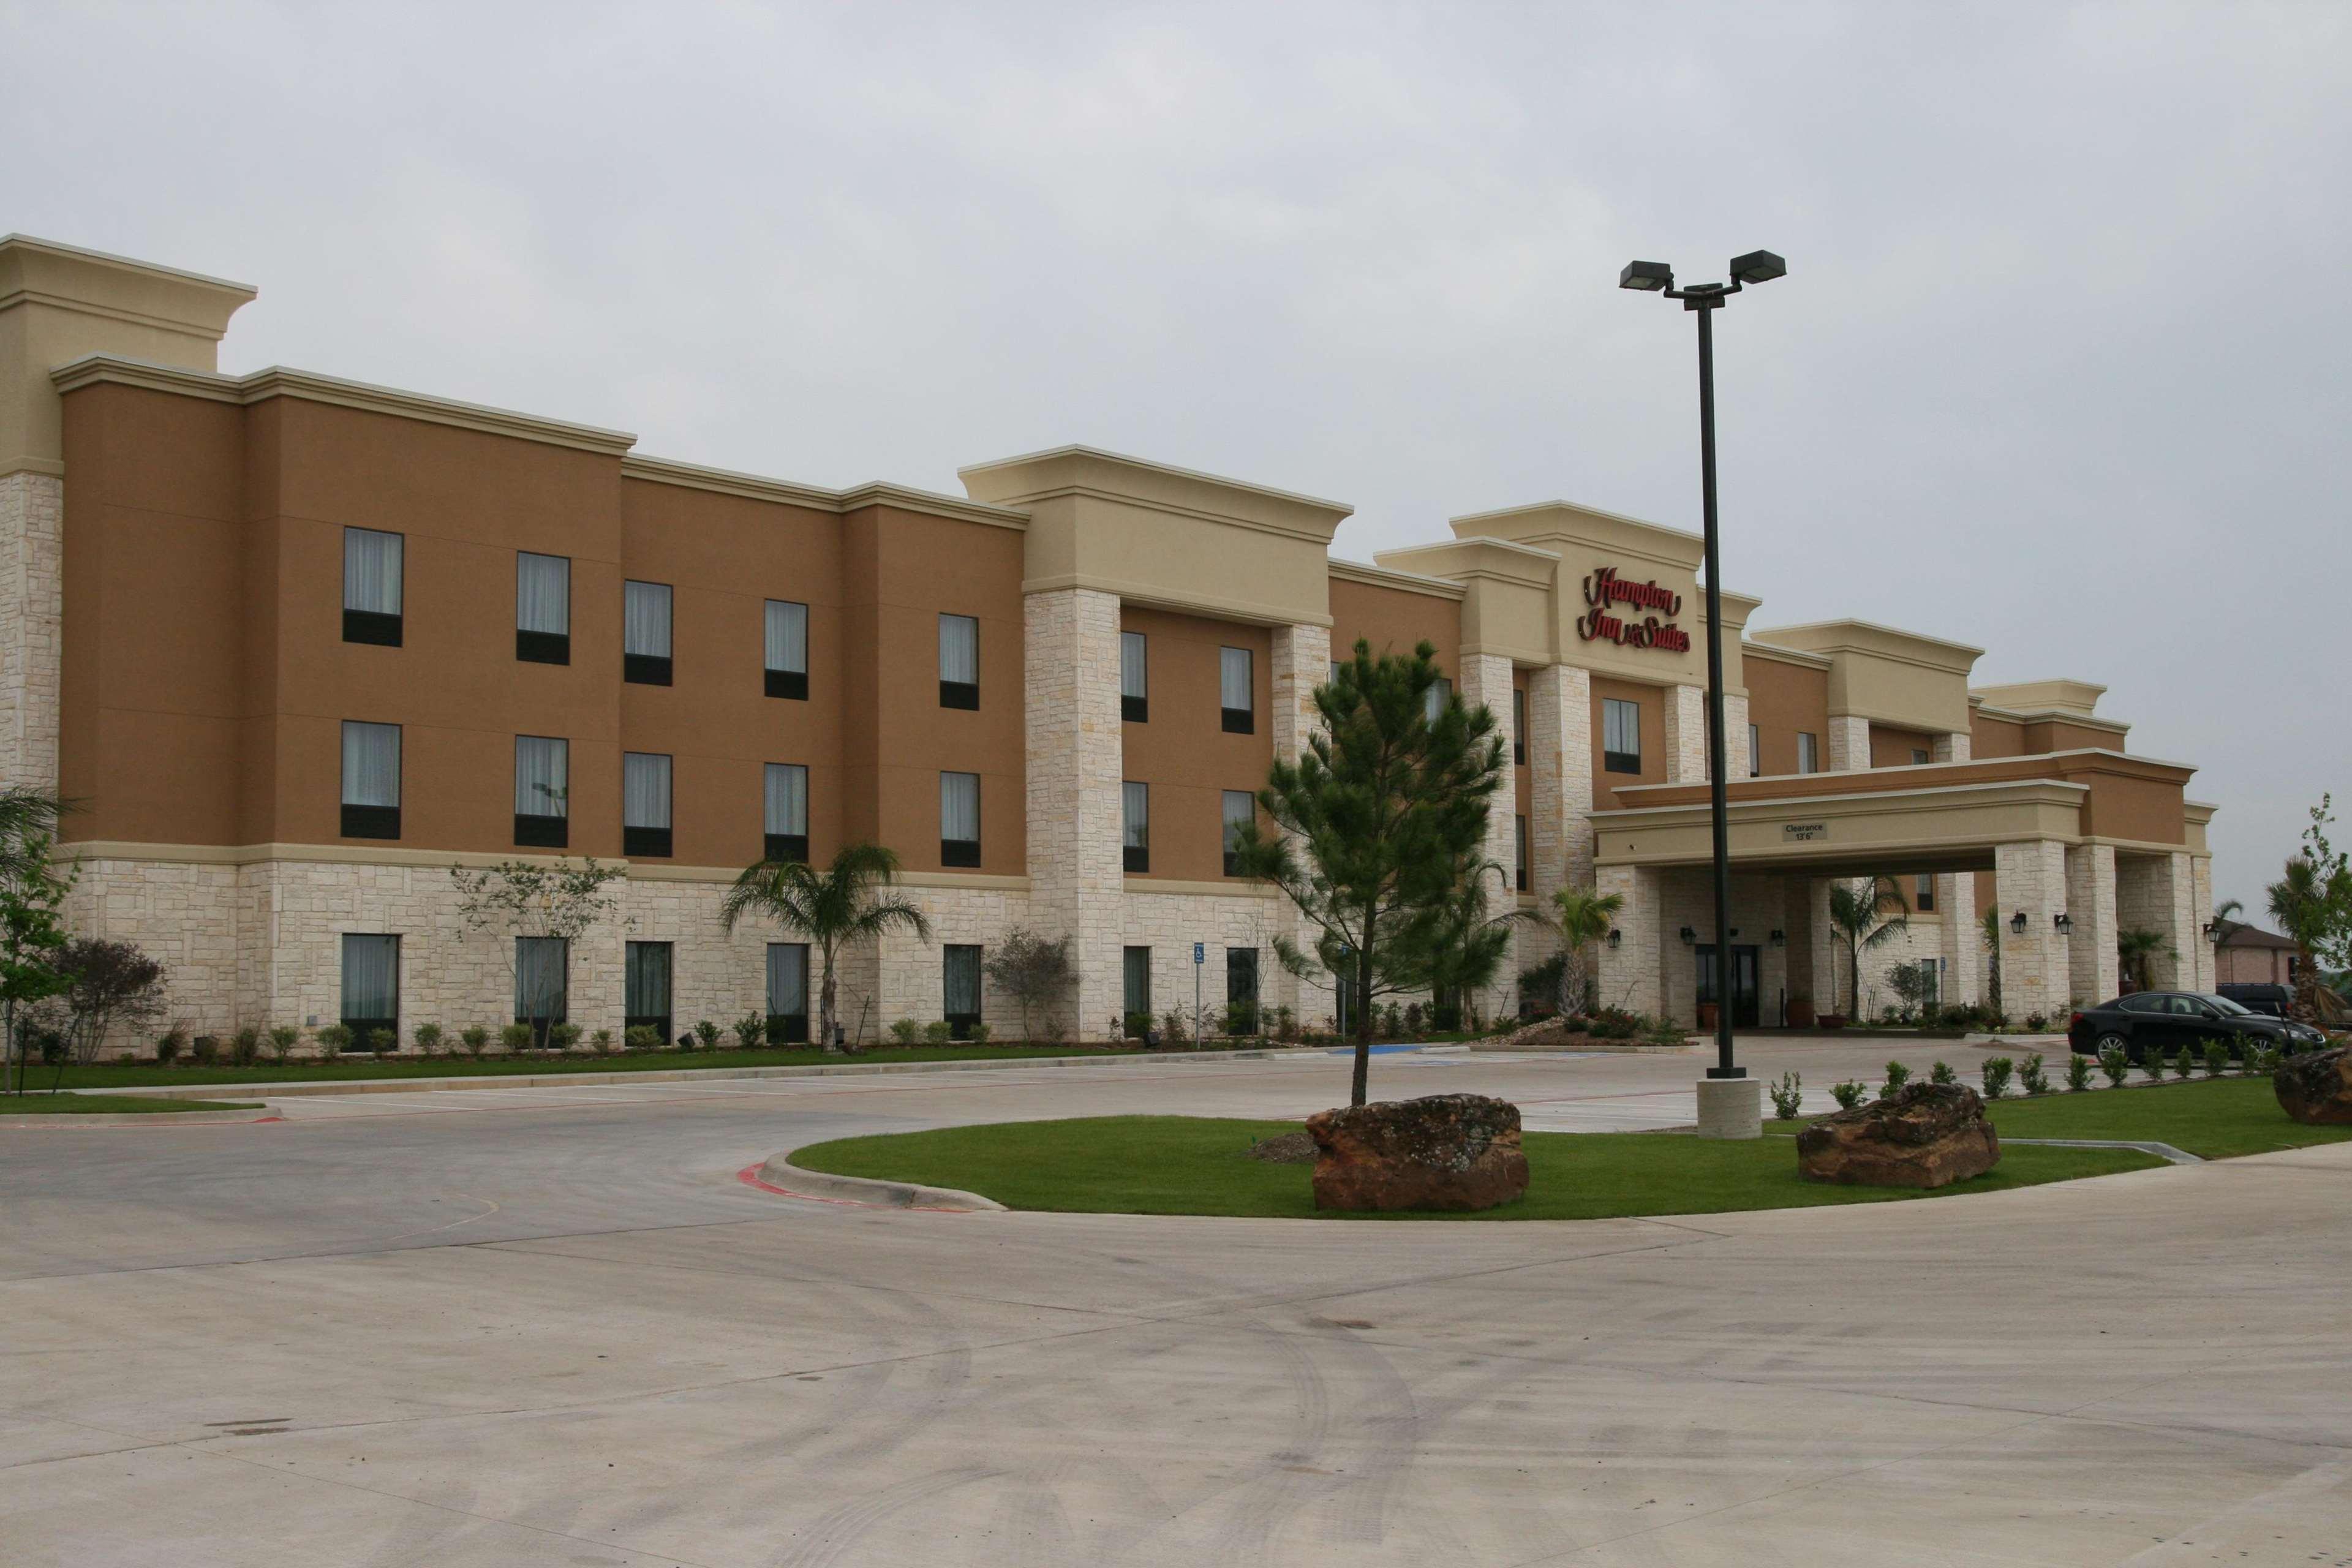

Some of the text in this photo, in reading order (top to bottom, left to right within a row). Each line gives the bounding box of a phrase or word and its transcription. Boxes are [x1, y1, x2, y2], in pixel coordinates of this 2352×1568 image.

[1583, 567, 1681, 617] Hampton
[1577, 608, 1630, 646] Inn
[1640, 616, 1690, 652] Suites
